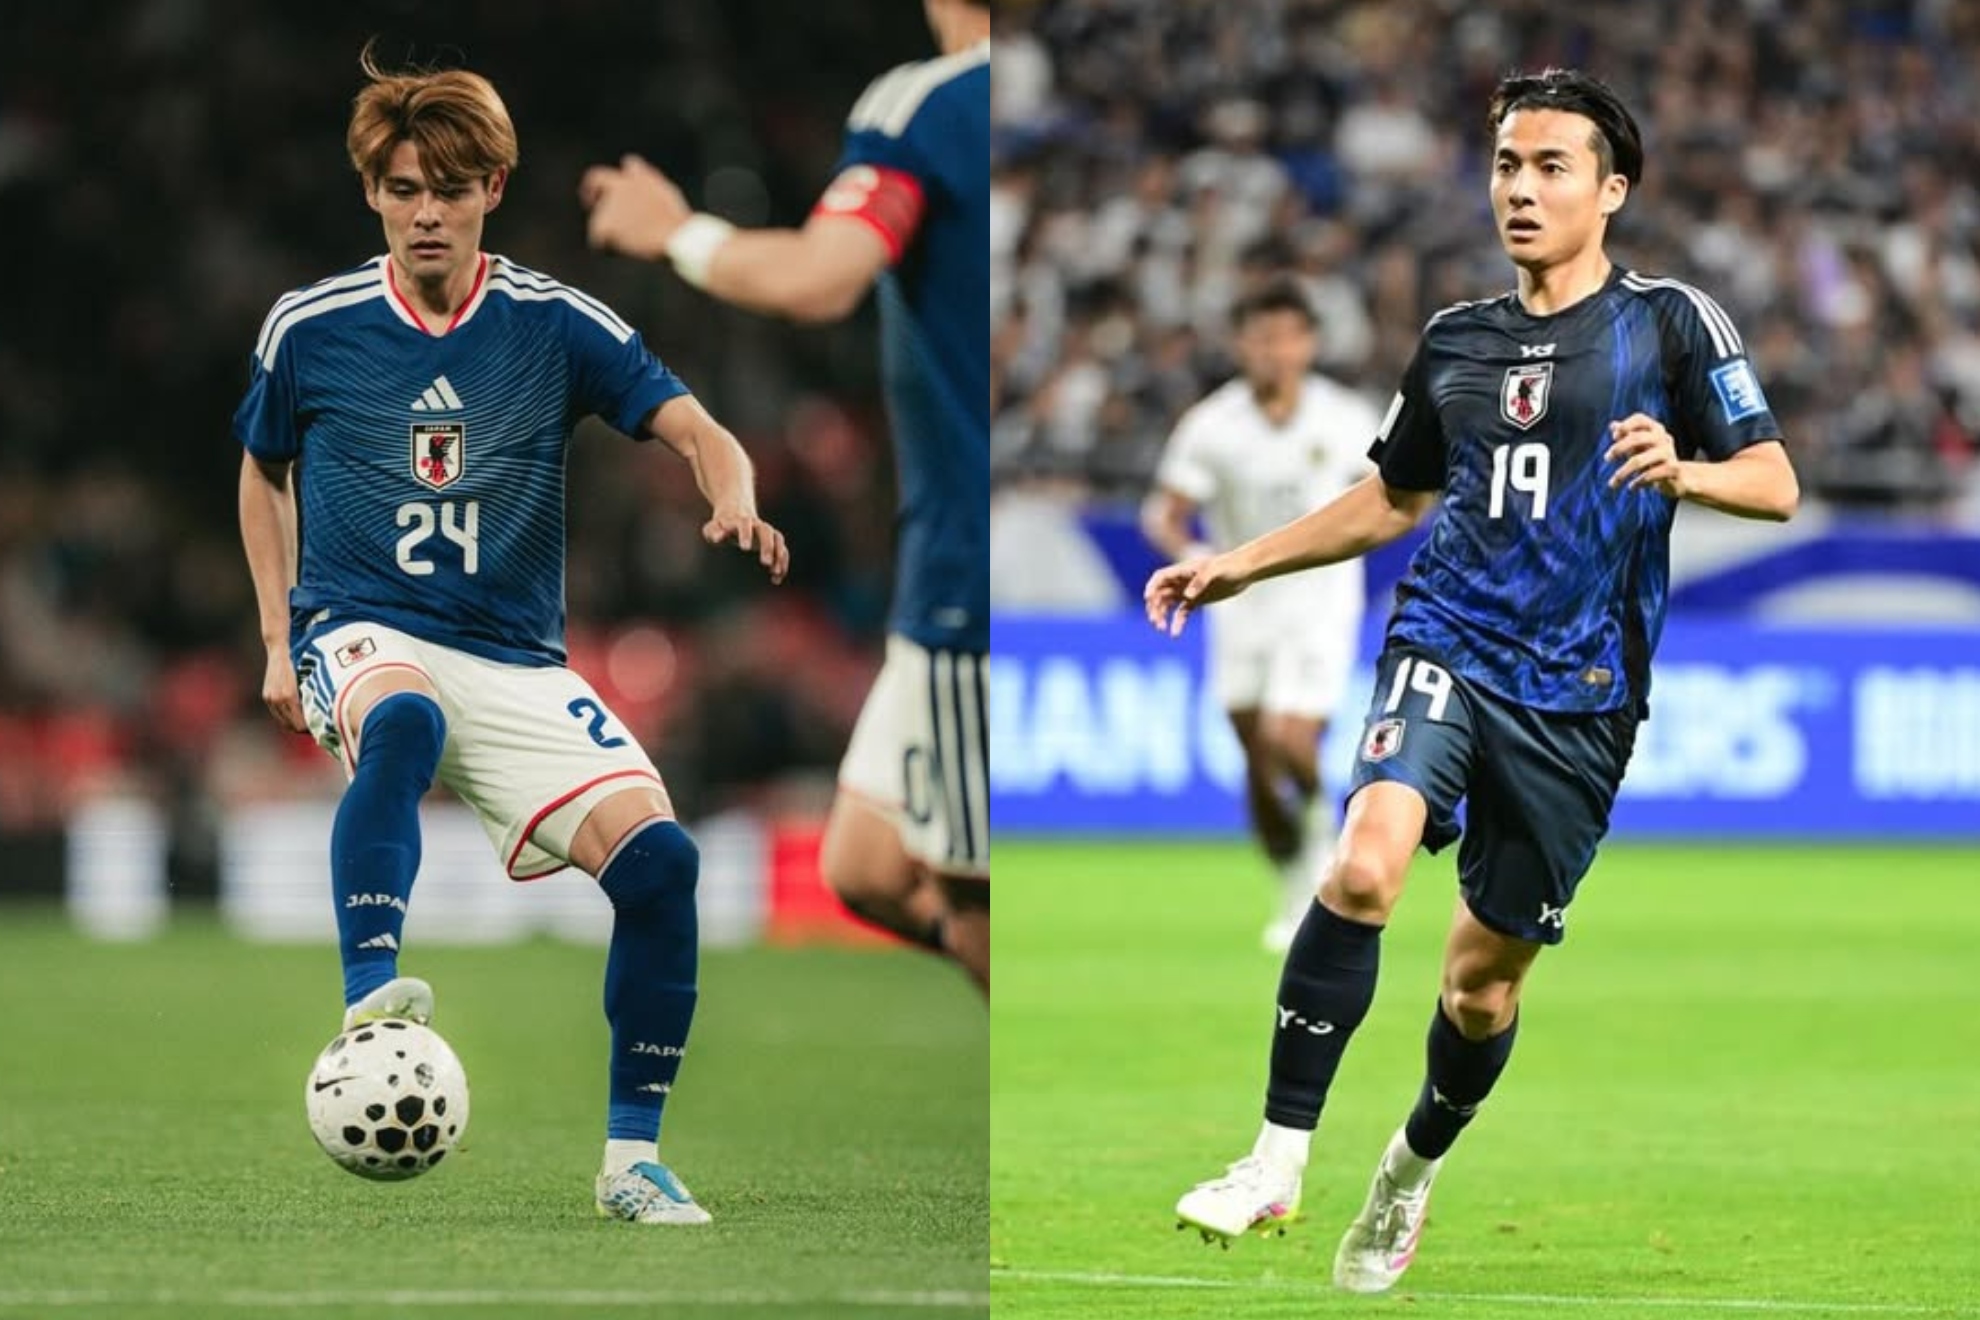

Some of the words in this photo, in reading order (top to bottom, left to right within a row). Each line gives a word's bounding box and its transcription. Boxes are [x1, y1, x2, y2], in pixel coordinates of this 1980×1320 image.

[1488, 442, 1550, 519] 19
[396, 502, 479, 574] 24
[567, 697, 628, 748] 2
[1384, 657, 1453, 721] 19
